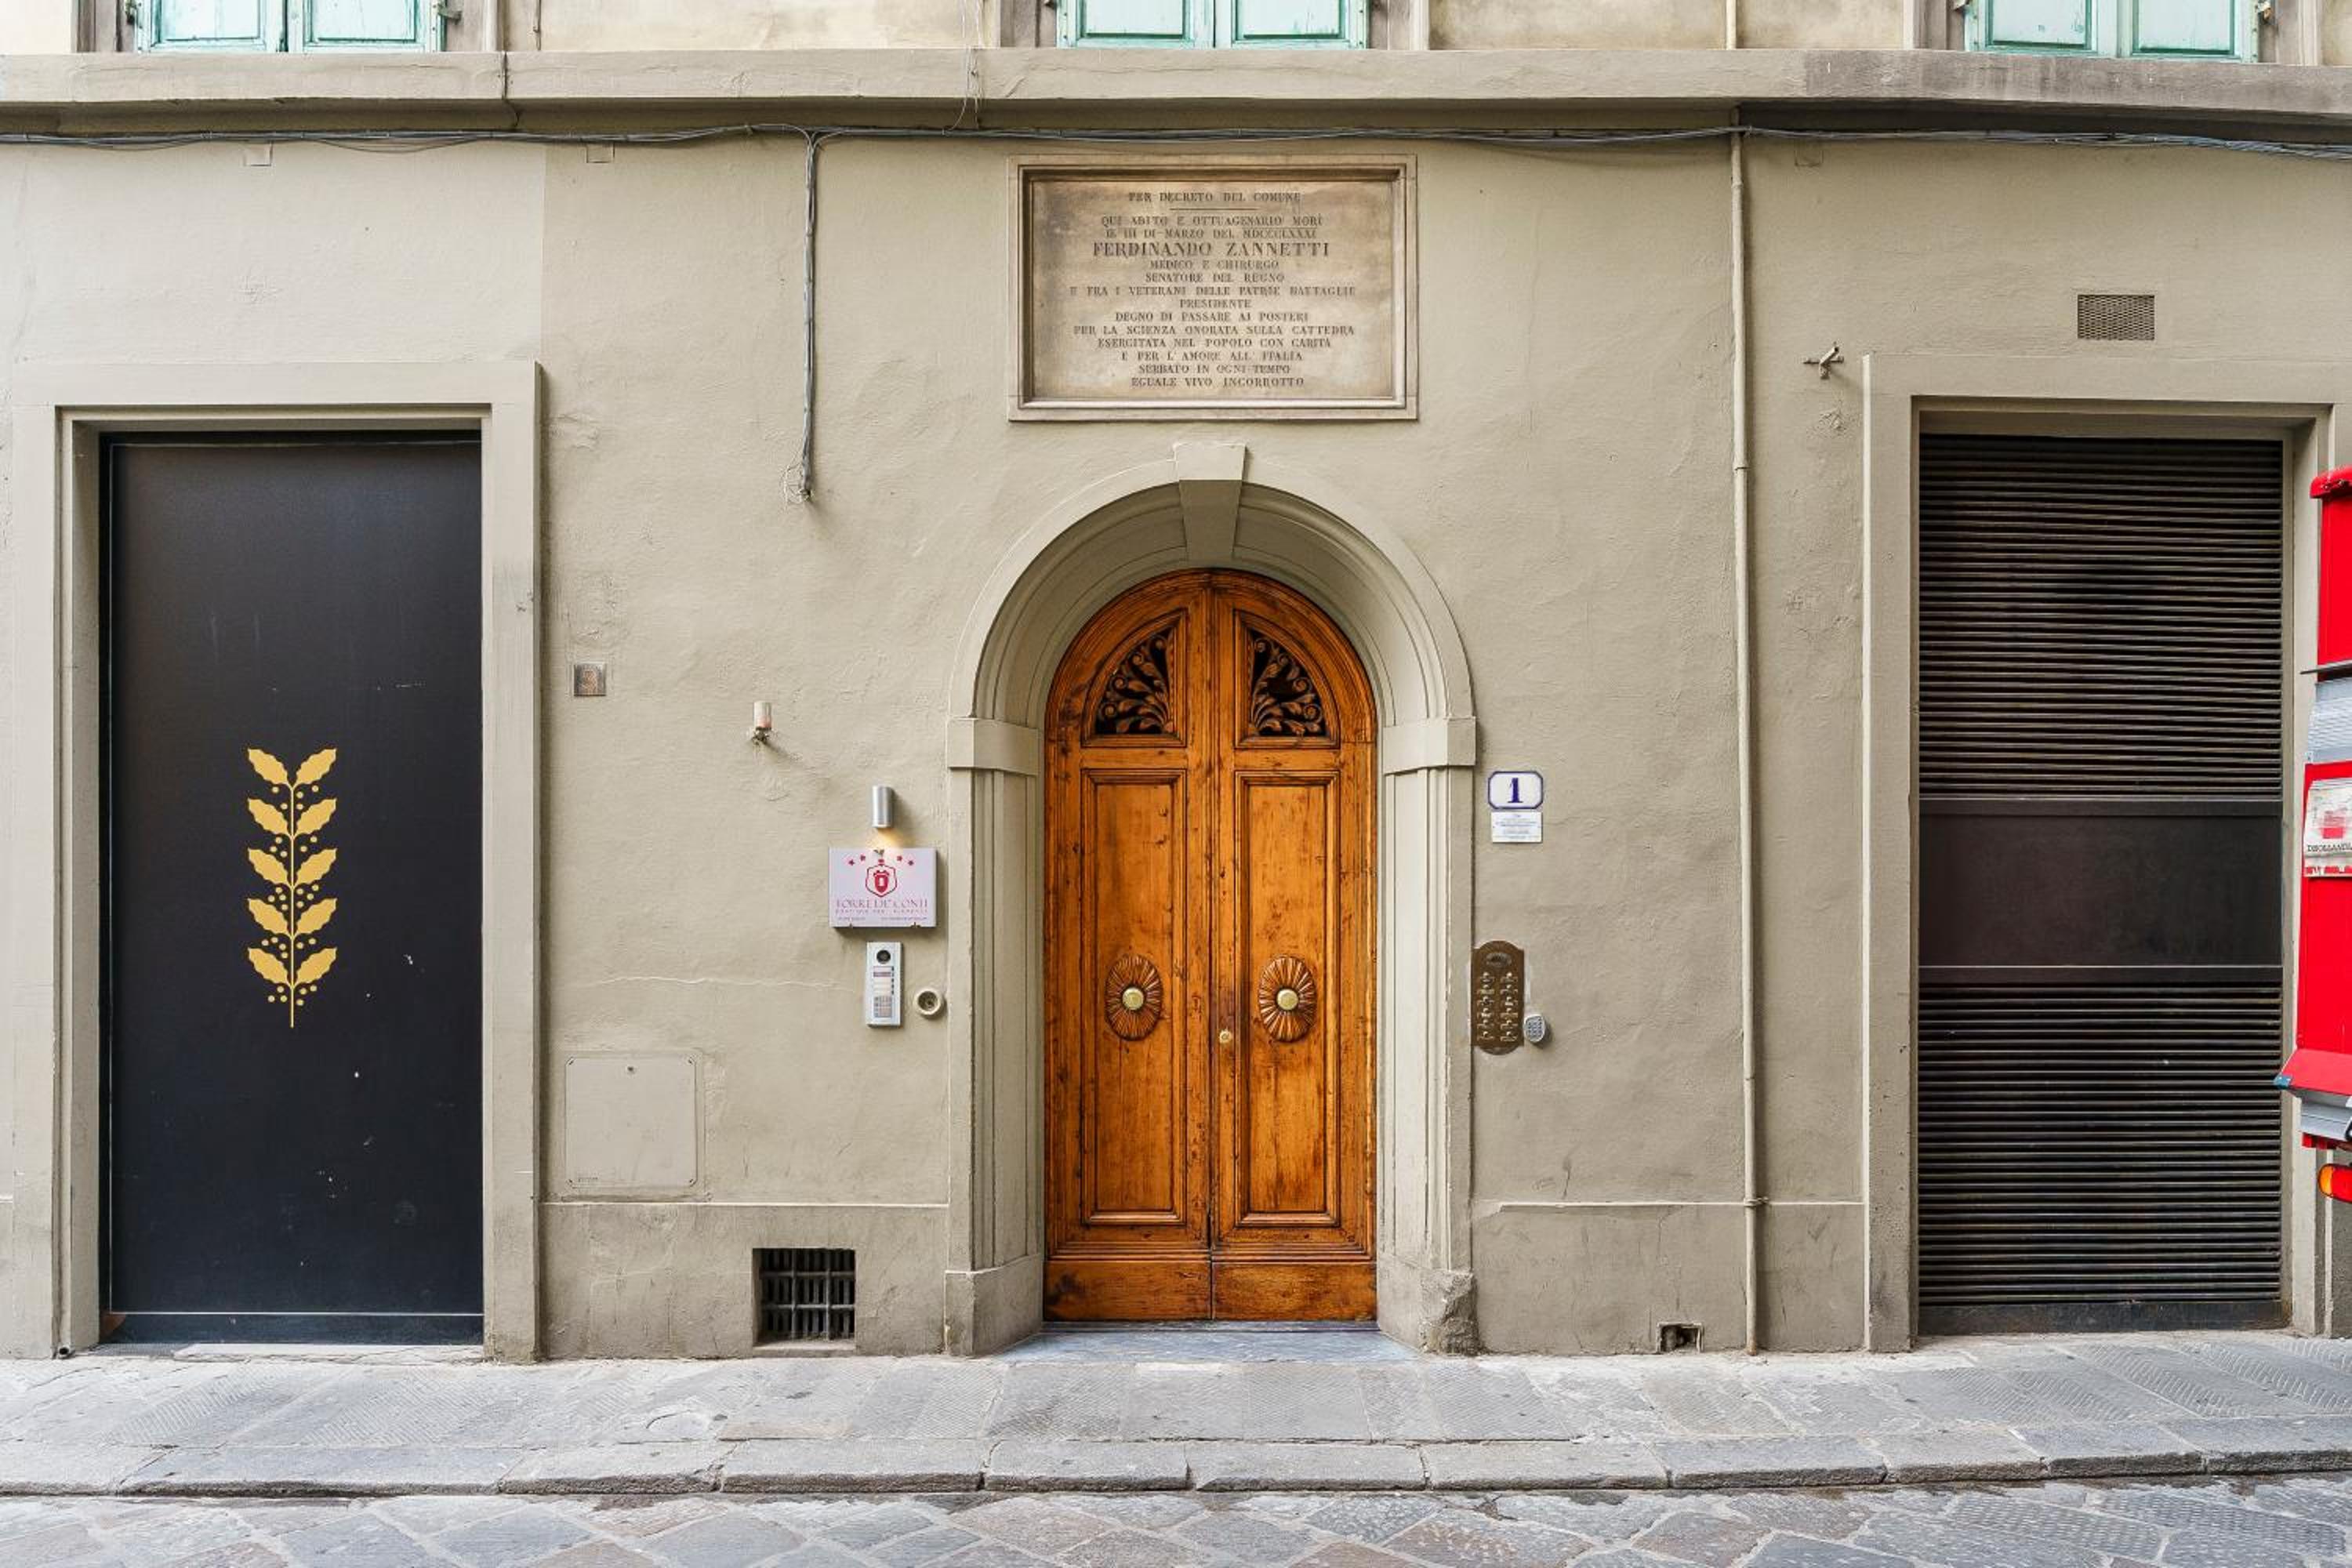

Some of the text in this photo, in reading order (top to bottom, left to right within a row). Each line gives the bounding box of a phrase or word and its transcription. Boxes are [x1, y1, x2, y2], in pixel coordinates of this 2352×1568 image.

[1129, 192, 1301, 202] PER DECRETO DEL COMUNE
[1101, 216, 1121, 227] QUI
[1178, 216, 1185, 226] E
[1192, 216, 1282, 226] OTTUAGENARIO
[1144, 228, 1156, 238] DI
[1165, 228, 1204, 238] MARZO
[1213, 228, 1234, 238] DEL
[1093, 242, 1329, 258] FERDINANDO ZANNETTI
[1150, 260, 1279, 270] MEDICO E CHIRURGO
[1145, 273, 1285, 283] SENATORE DEL REGNO
[1116, 286, 1120, 296] I
[1129, 286, 1186, 296] VETERANI
[1196, 286, 1229, 296] DELLE
[1239, 286, 1280, 296] PATRIE
[1290, 286, 1356, 296] BATTAGLIE
[1180, 299, 1252, 309] PRESIDENTE
[1116, 312, 1308, 322] DEGNO DI PASSARE AI POSTERI
[1073, 325, 1355, 336] PER LA SCIENZA ONORATA SULLA CATTEDRA
[1098, 338, 1166, 348] ESERCITATA
[1174, 338, 1196, 348] NEL
[1205, 338, 1252, 347] POPOLO
[1260, 338, 1283, 347] CON
[1121, 352, 1128, 361] E
[1138, 352, 1160, 361] PER
[1181, 352, 1221, 361] AMORE
[1262, 352, 1303, 361] ITALIA
[1138, 365, 1290, 374] SERBATO IN OGNI TEMPO
[1131, 377, 1305, 387] EGUALE VIVO INCORROTTO
[1508, 777, 1523, 804] 1
